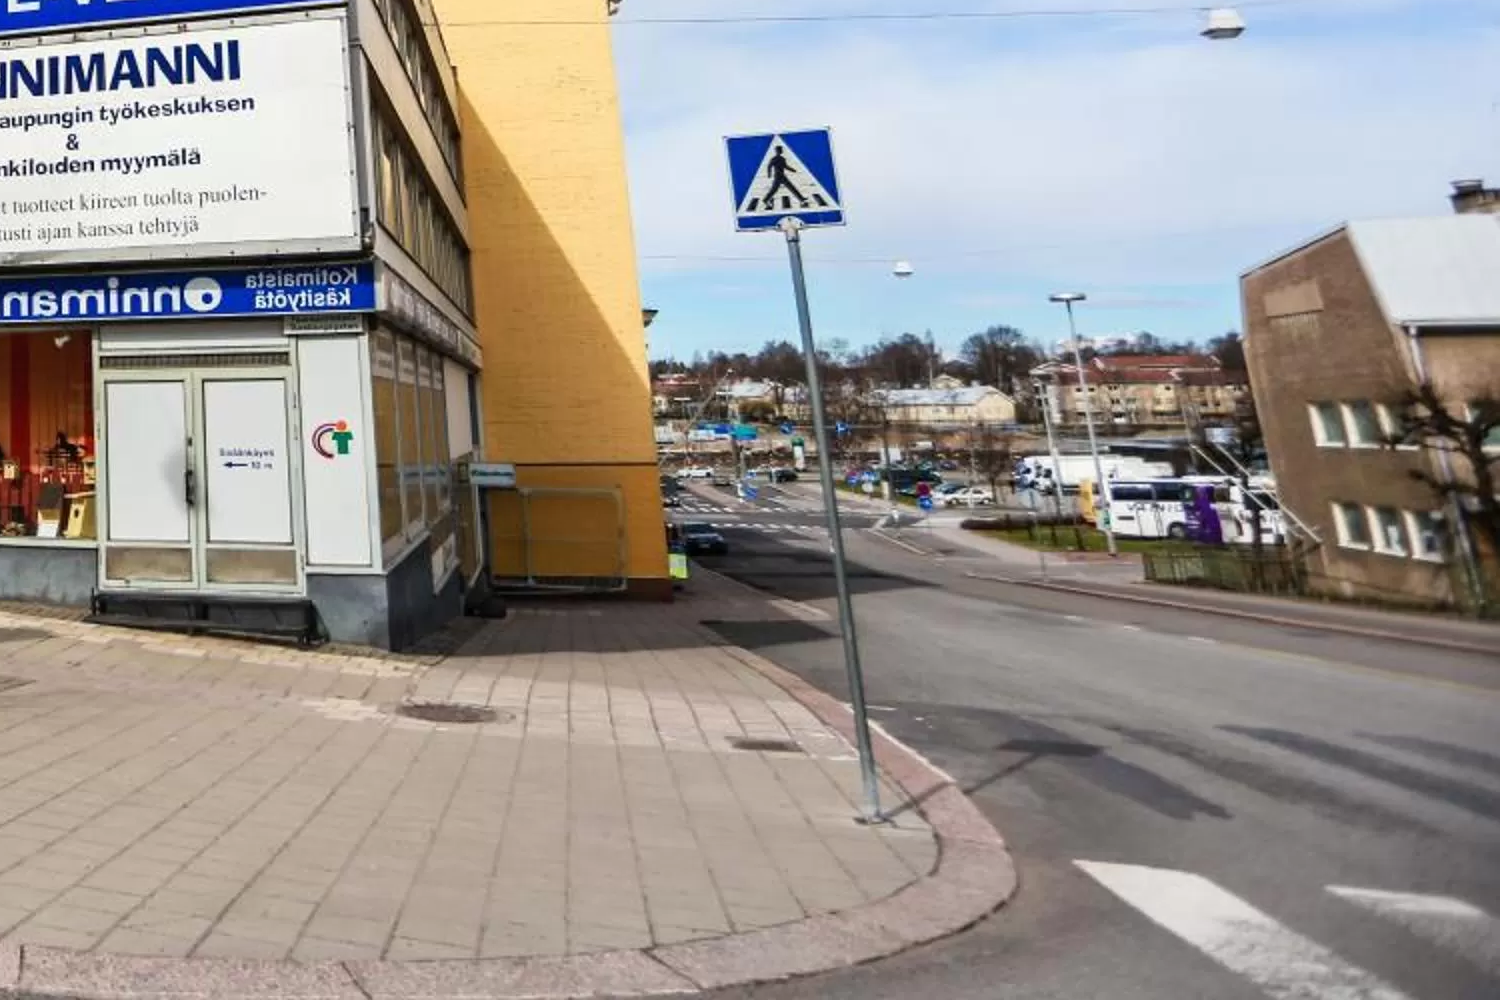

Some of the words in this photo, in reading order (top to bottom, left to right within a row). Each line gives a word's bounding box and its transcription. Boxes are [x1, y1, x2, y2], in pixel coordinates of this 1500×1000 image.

[99, 96, 255, 126] työkeskuksen
[65, 133, 80, 151] &
[101, 148, 201, 175] myymälä
[12, 197, 75, 215] tuotteet
[79, 194, 137, 210] kiireen
[143, 188, 194, 207] tuolta
[198, 184, 267, 208] puolen-
[37, 226, 72, 244] ajan
[77, 221, 133, 238] kanssa
[139, 215, 199, 237] tehtyjä
